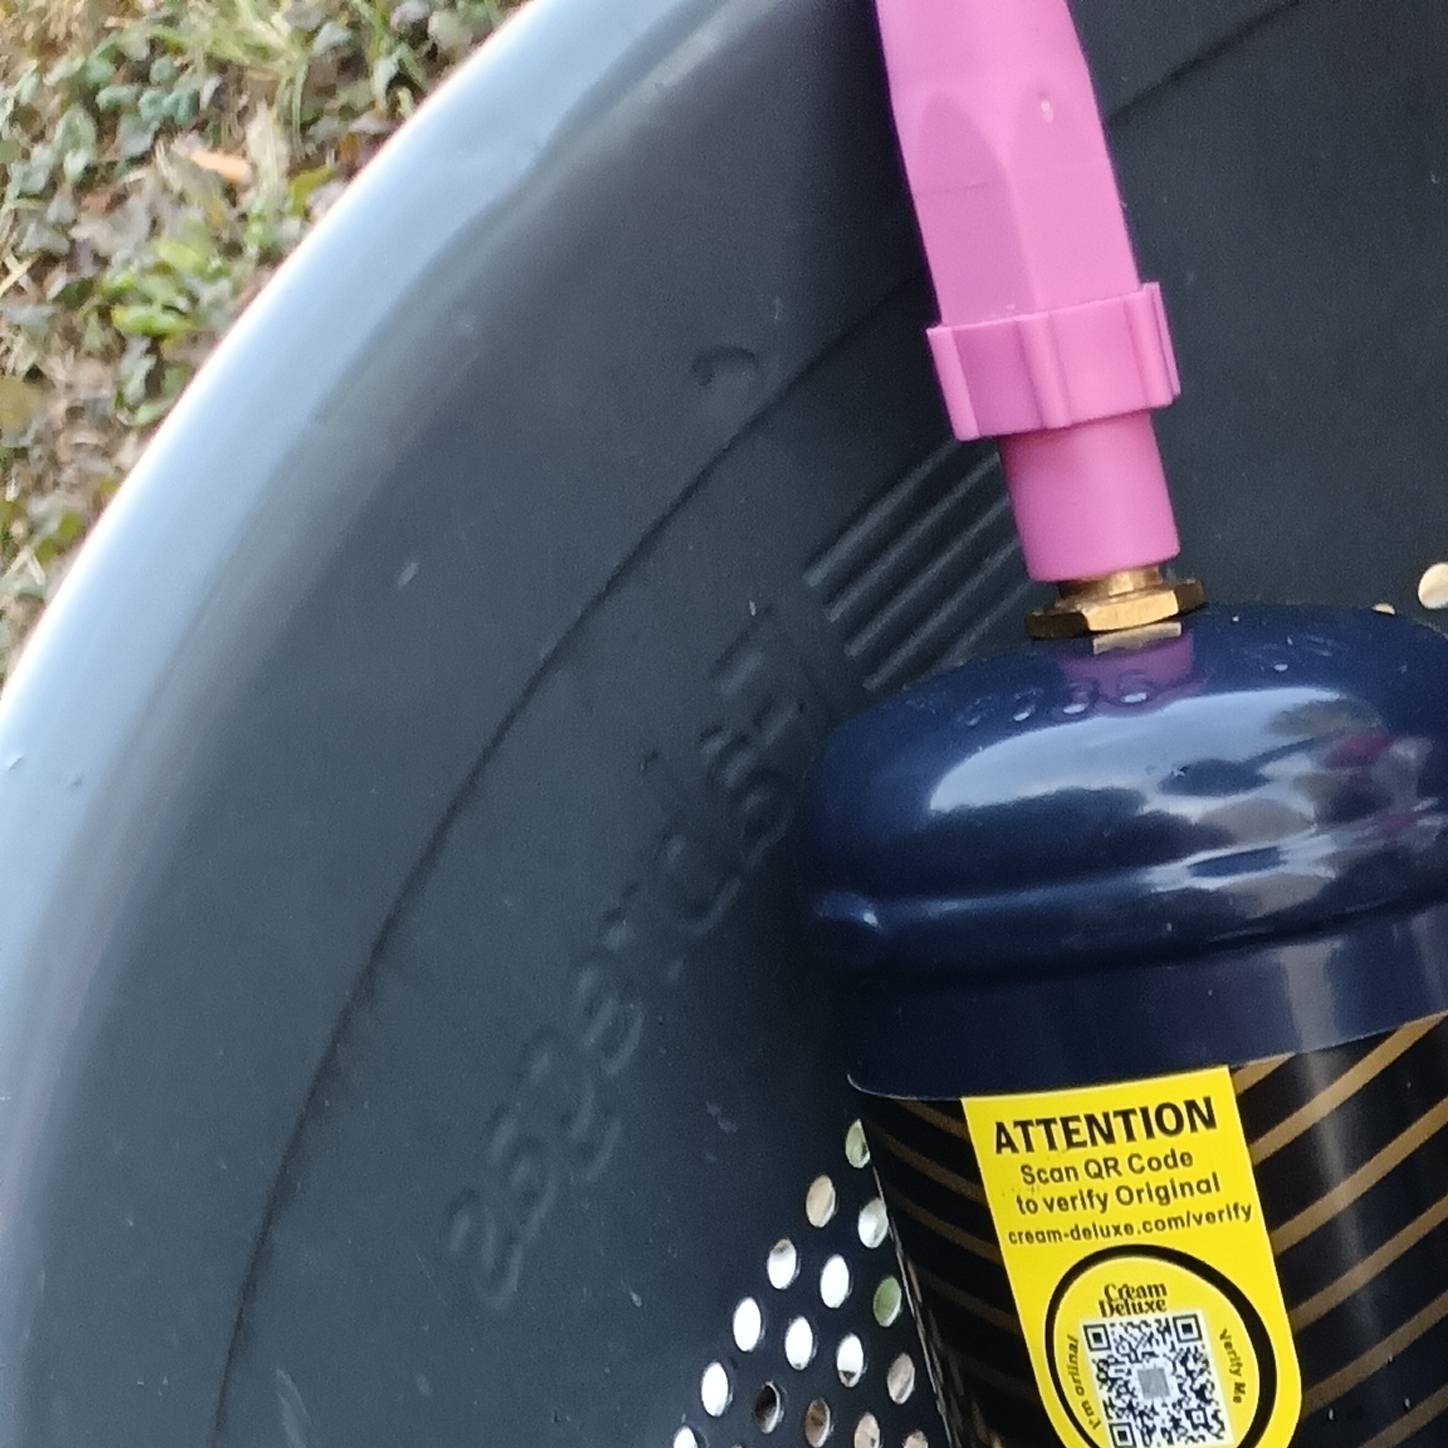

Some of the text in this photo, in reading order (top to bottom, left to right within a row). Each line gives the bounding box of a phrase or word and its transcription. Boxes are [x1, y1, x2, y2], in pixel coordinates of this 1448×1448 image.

[994, 1097, 1218, 1154] ATTENTION
[1021, 1149, 1193, 1186] Scan QR Code
[1016, 1172, 1222, 1215] to verify Original
[1007, 1202, 1253, 1246] cream-deluxe.com/verify
[1098, 1298, 1168, 1319] Deluxe
[1102, 1281, 1168, 1302] Cream
